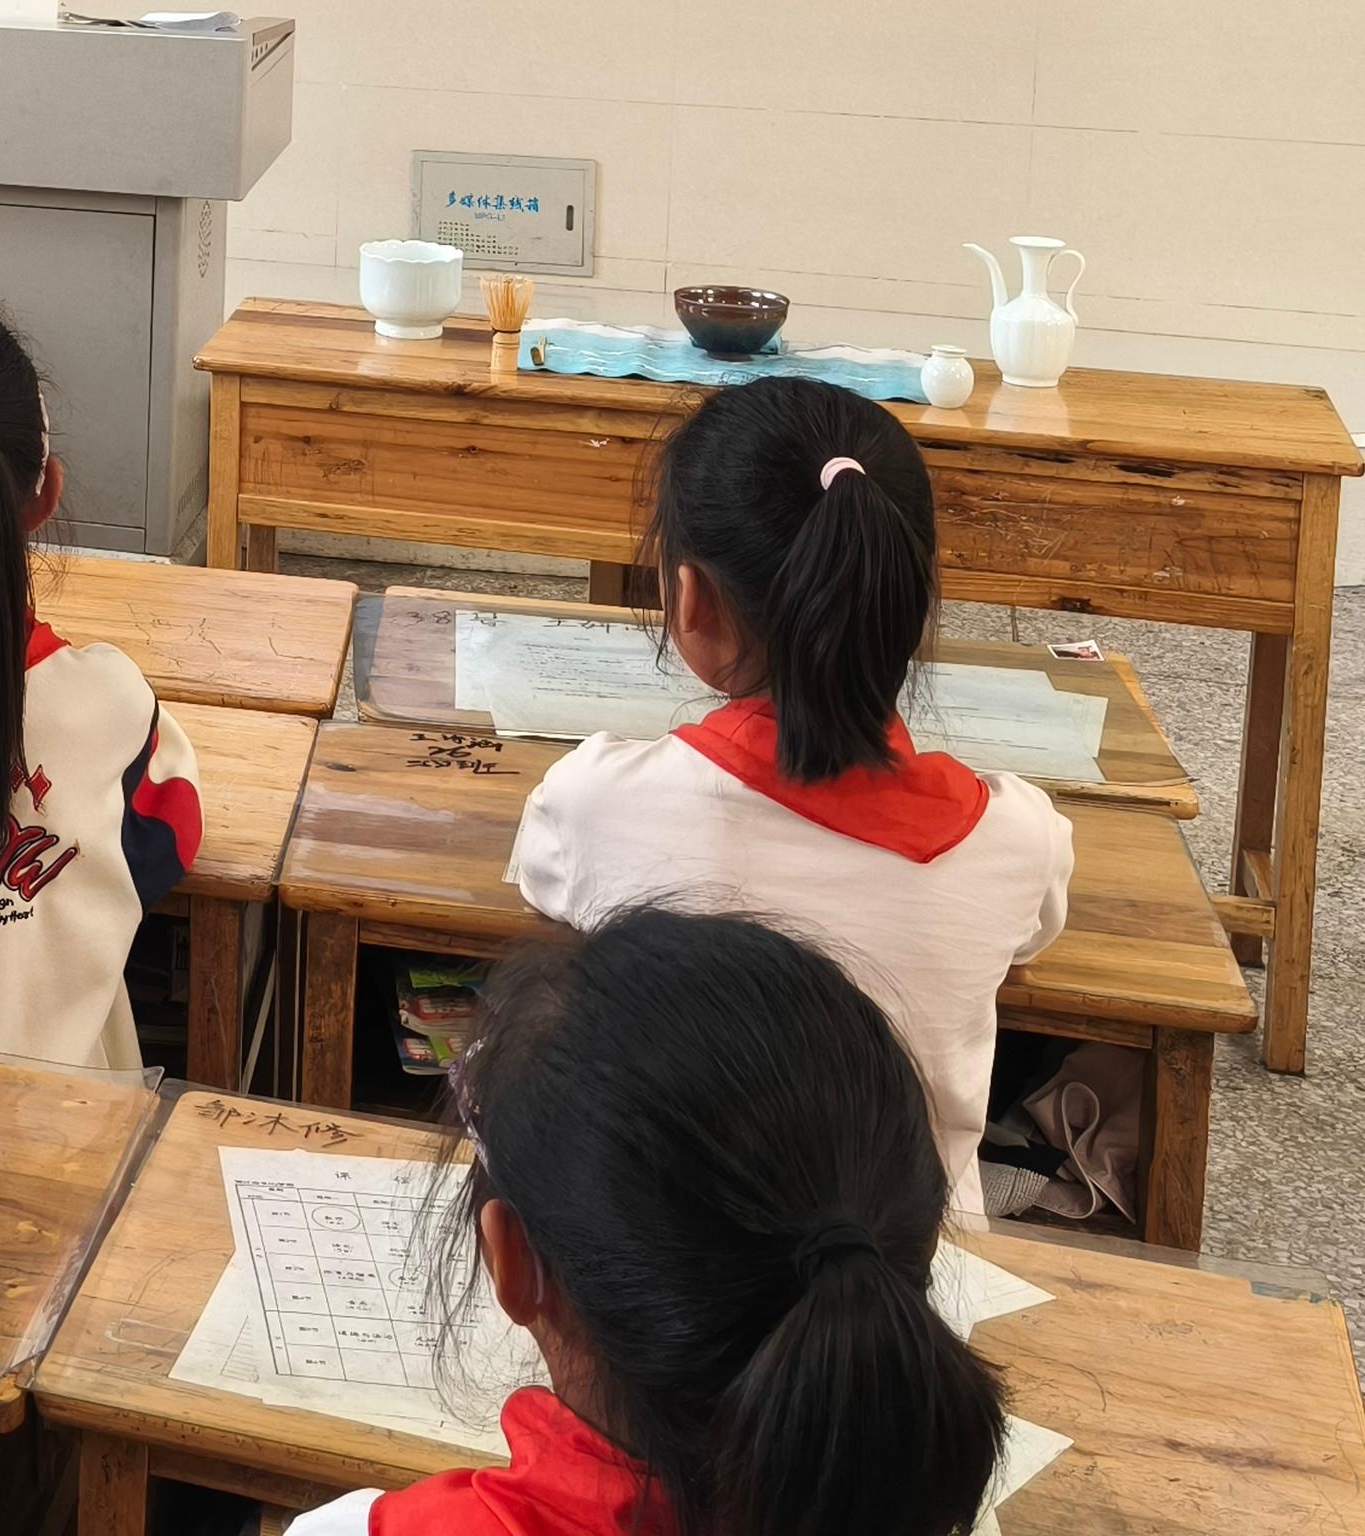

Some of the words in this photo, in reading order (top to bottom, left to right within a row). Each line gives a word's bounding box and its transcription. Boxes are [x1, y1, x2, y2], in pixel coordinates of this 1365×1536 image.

[445, 191, 541, 214] 多媒体集线箱
